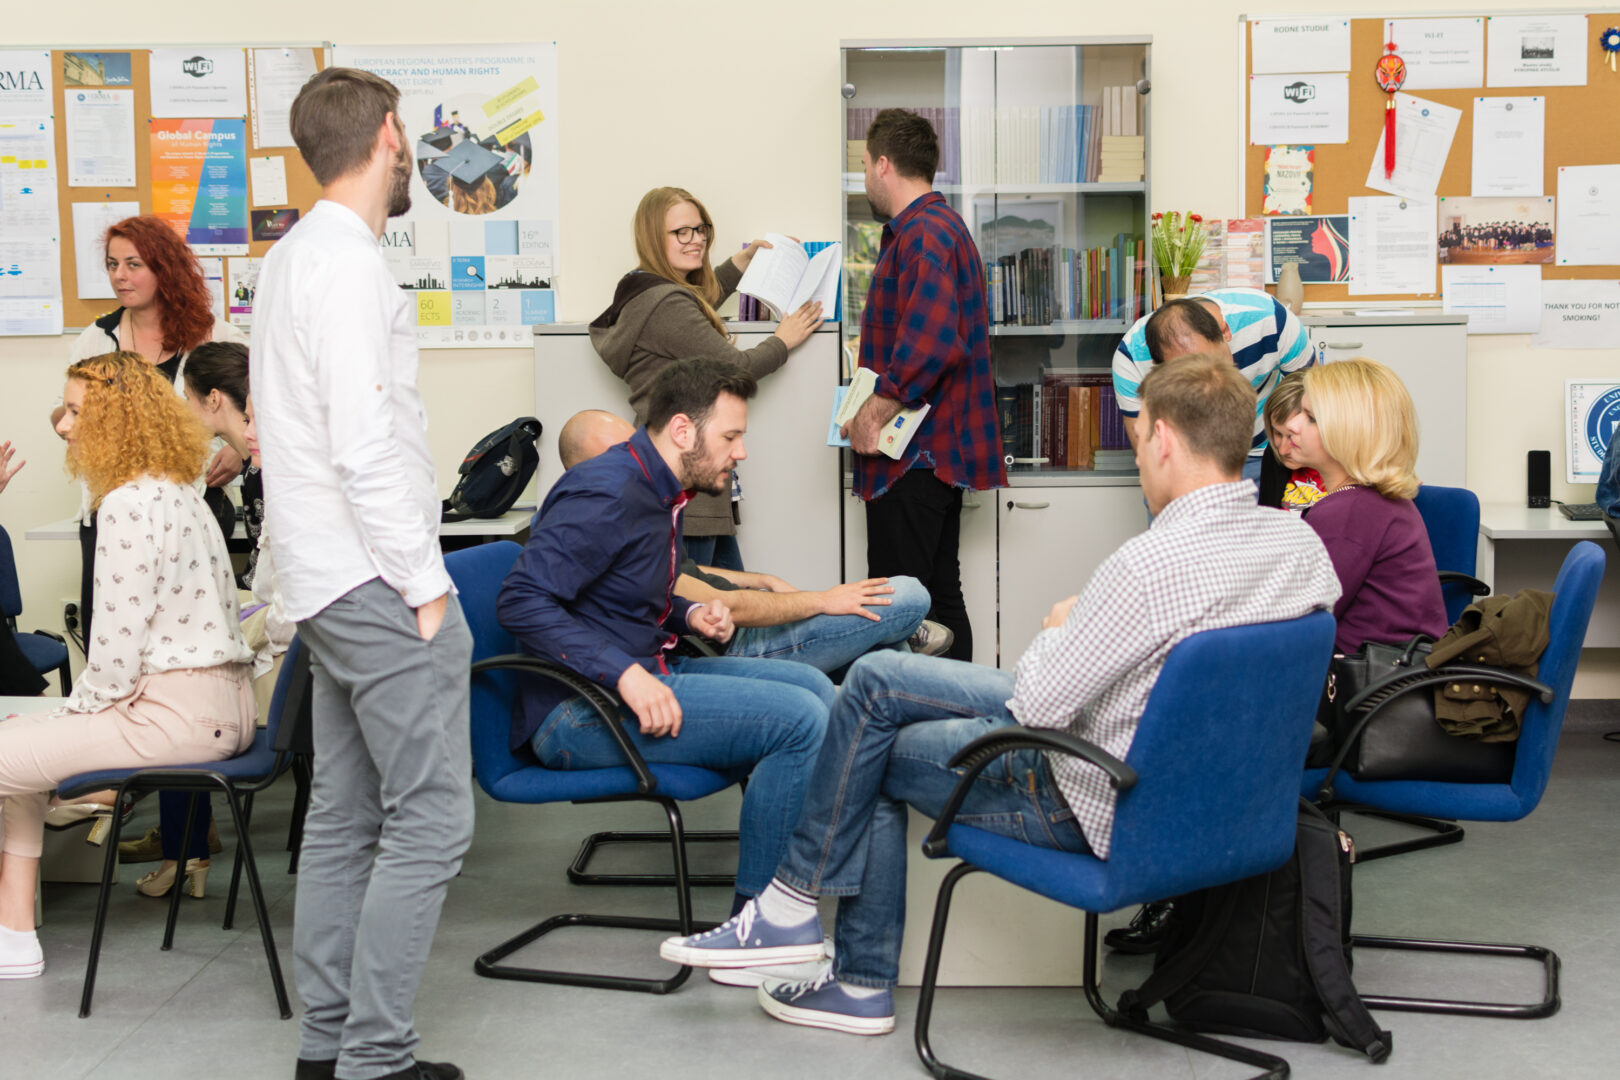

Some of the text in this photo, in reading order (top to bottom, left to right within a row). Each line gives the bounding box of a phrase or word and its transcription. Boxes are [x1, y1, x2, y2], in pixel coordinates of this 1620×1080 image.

[354, 58, 395, 66] EUROPEAN
[397, 58, 434, 66] REGIONAL
[475, 56, 524, 65] PROGRAMME
[527, 56, 536, 64] IN
[411, 68, 430, 76] AND
[433, 68, 466, 76] HUMAN
[469, 67, 500, 75] RIGHTS
[413, 78, 443, 86] EUROPE
[158, 130, 236, 142] Global Campus
[521, 241, 550, 249] EDITION
[421, 299, 434, 310] 60
[456, 299, 462, 310] 3
[493, 299, 499, 309] 2
[1588, 302, 1603, 310] FOR
[421, 312, 440, 321] ECTS
